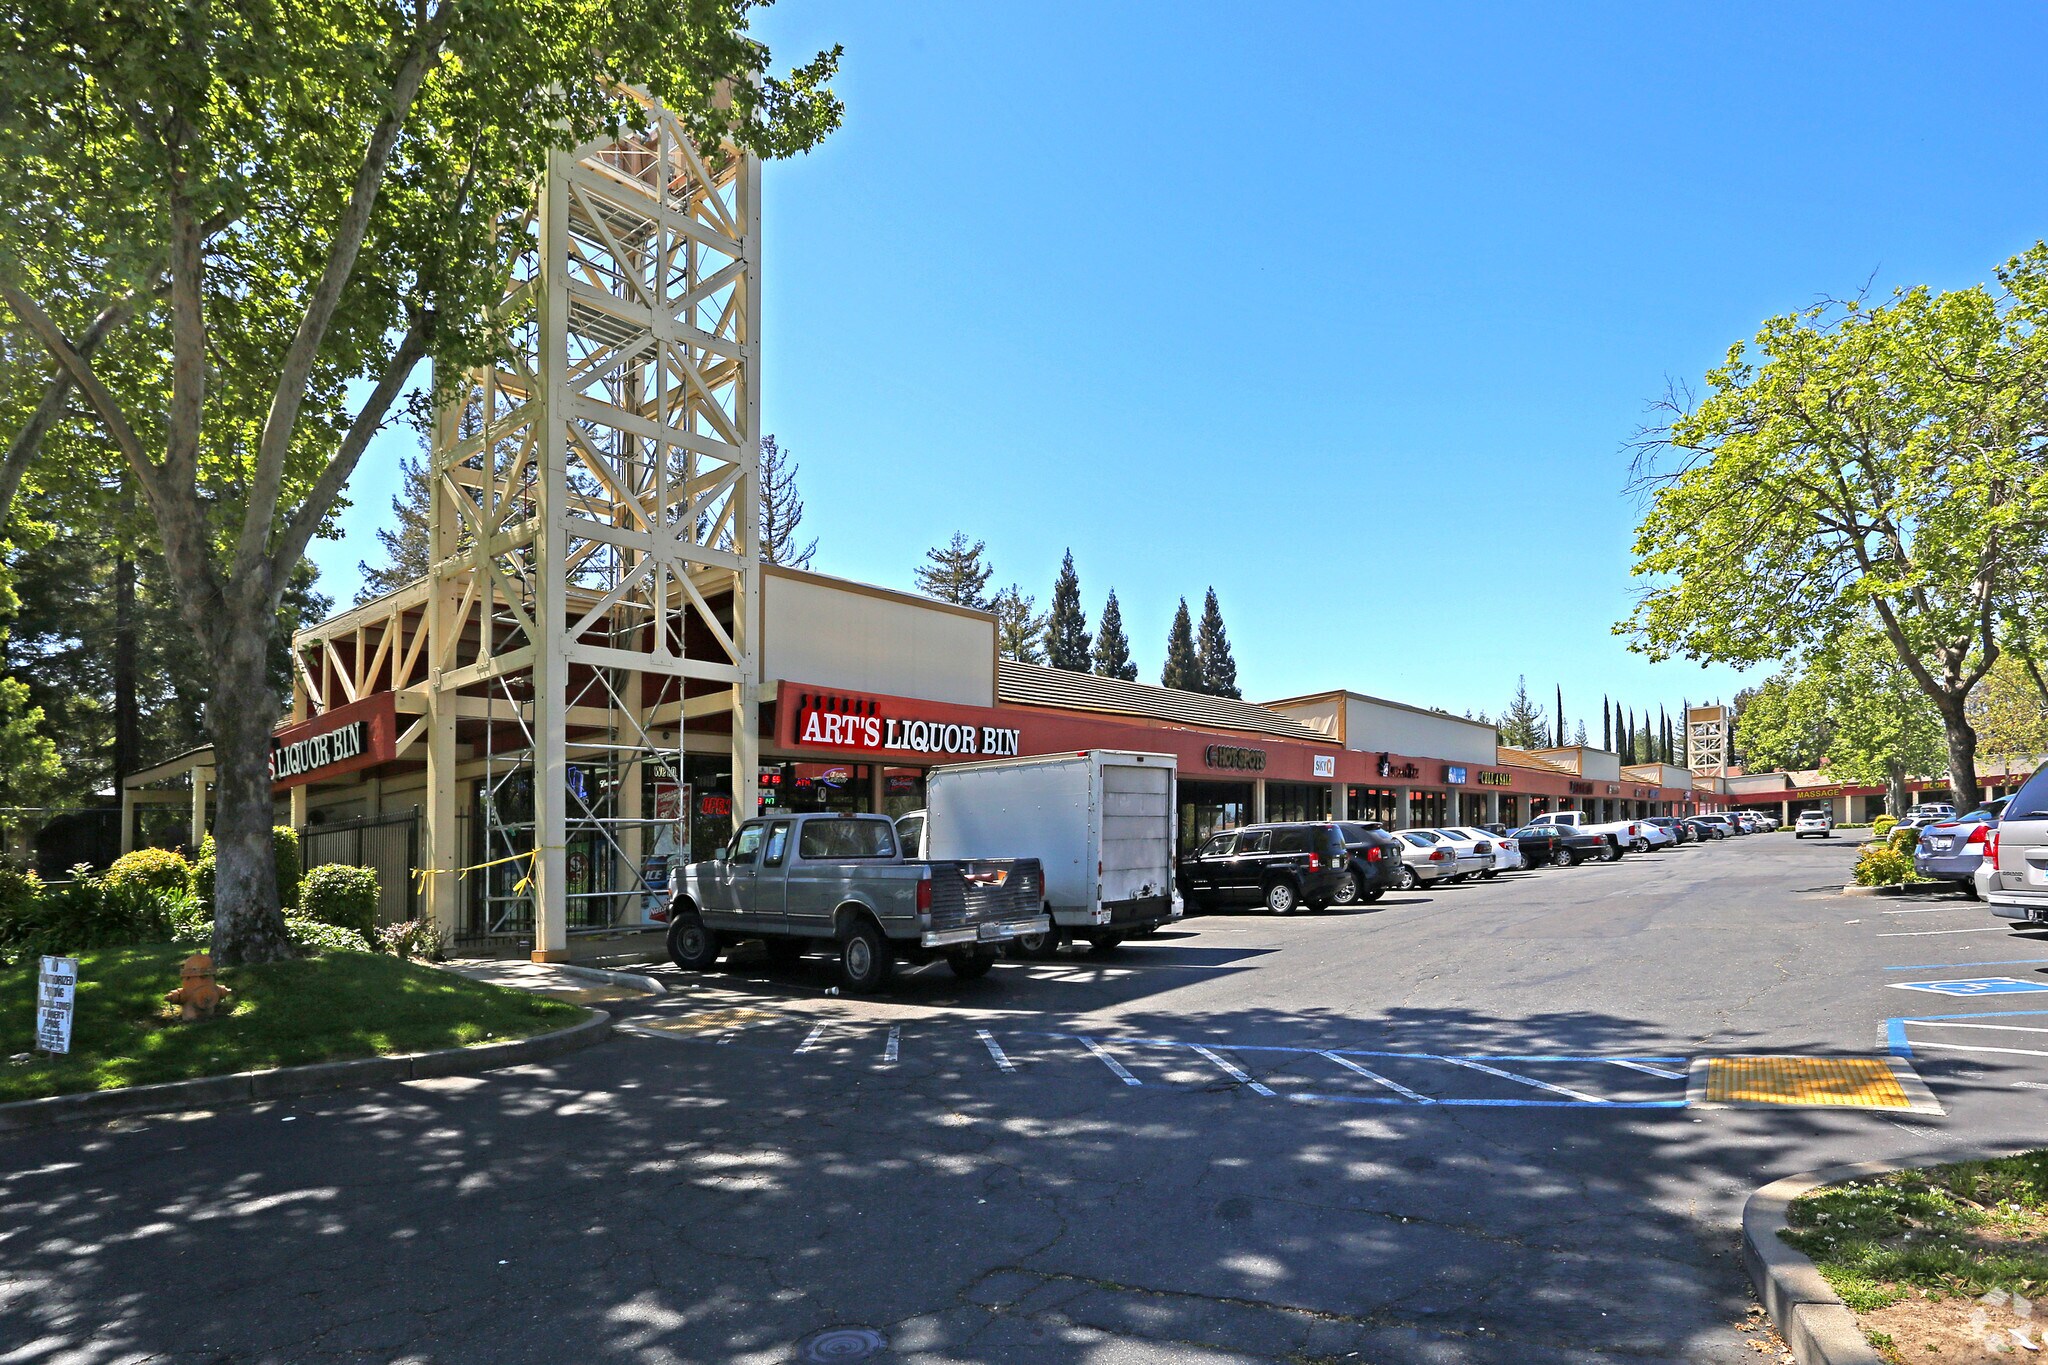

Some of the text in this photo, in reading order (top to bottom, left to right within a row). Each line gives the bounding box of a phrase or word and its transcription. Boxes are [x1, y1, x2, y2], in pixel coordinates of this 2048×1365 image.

[802, 711, 1020, 756] ART'S LIQUOR BIN
[276, 733, 331, 778] LIQUOR
[333, 721, 360, 761] BIN
[795, 779, 811, 787] ATM
[1922, 781, 1947, 790] BOOK
[1796, 788, 1840, 799] MASSAGE
[645, 870, 662, 880] ICE
